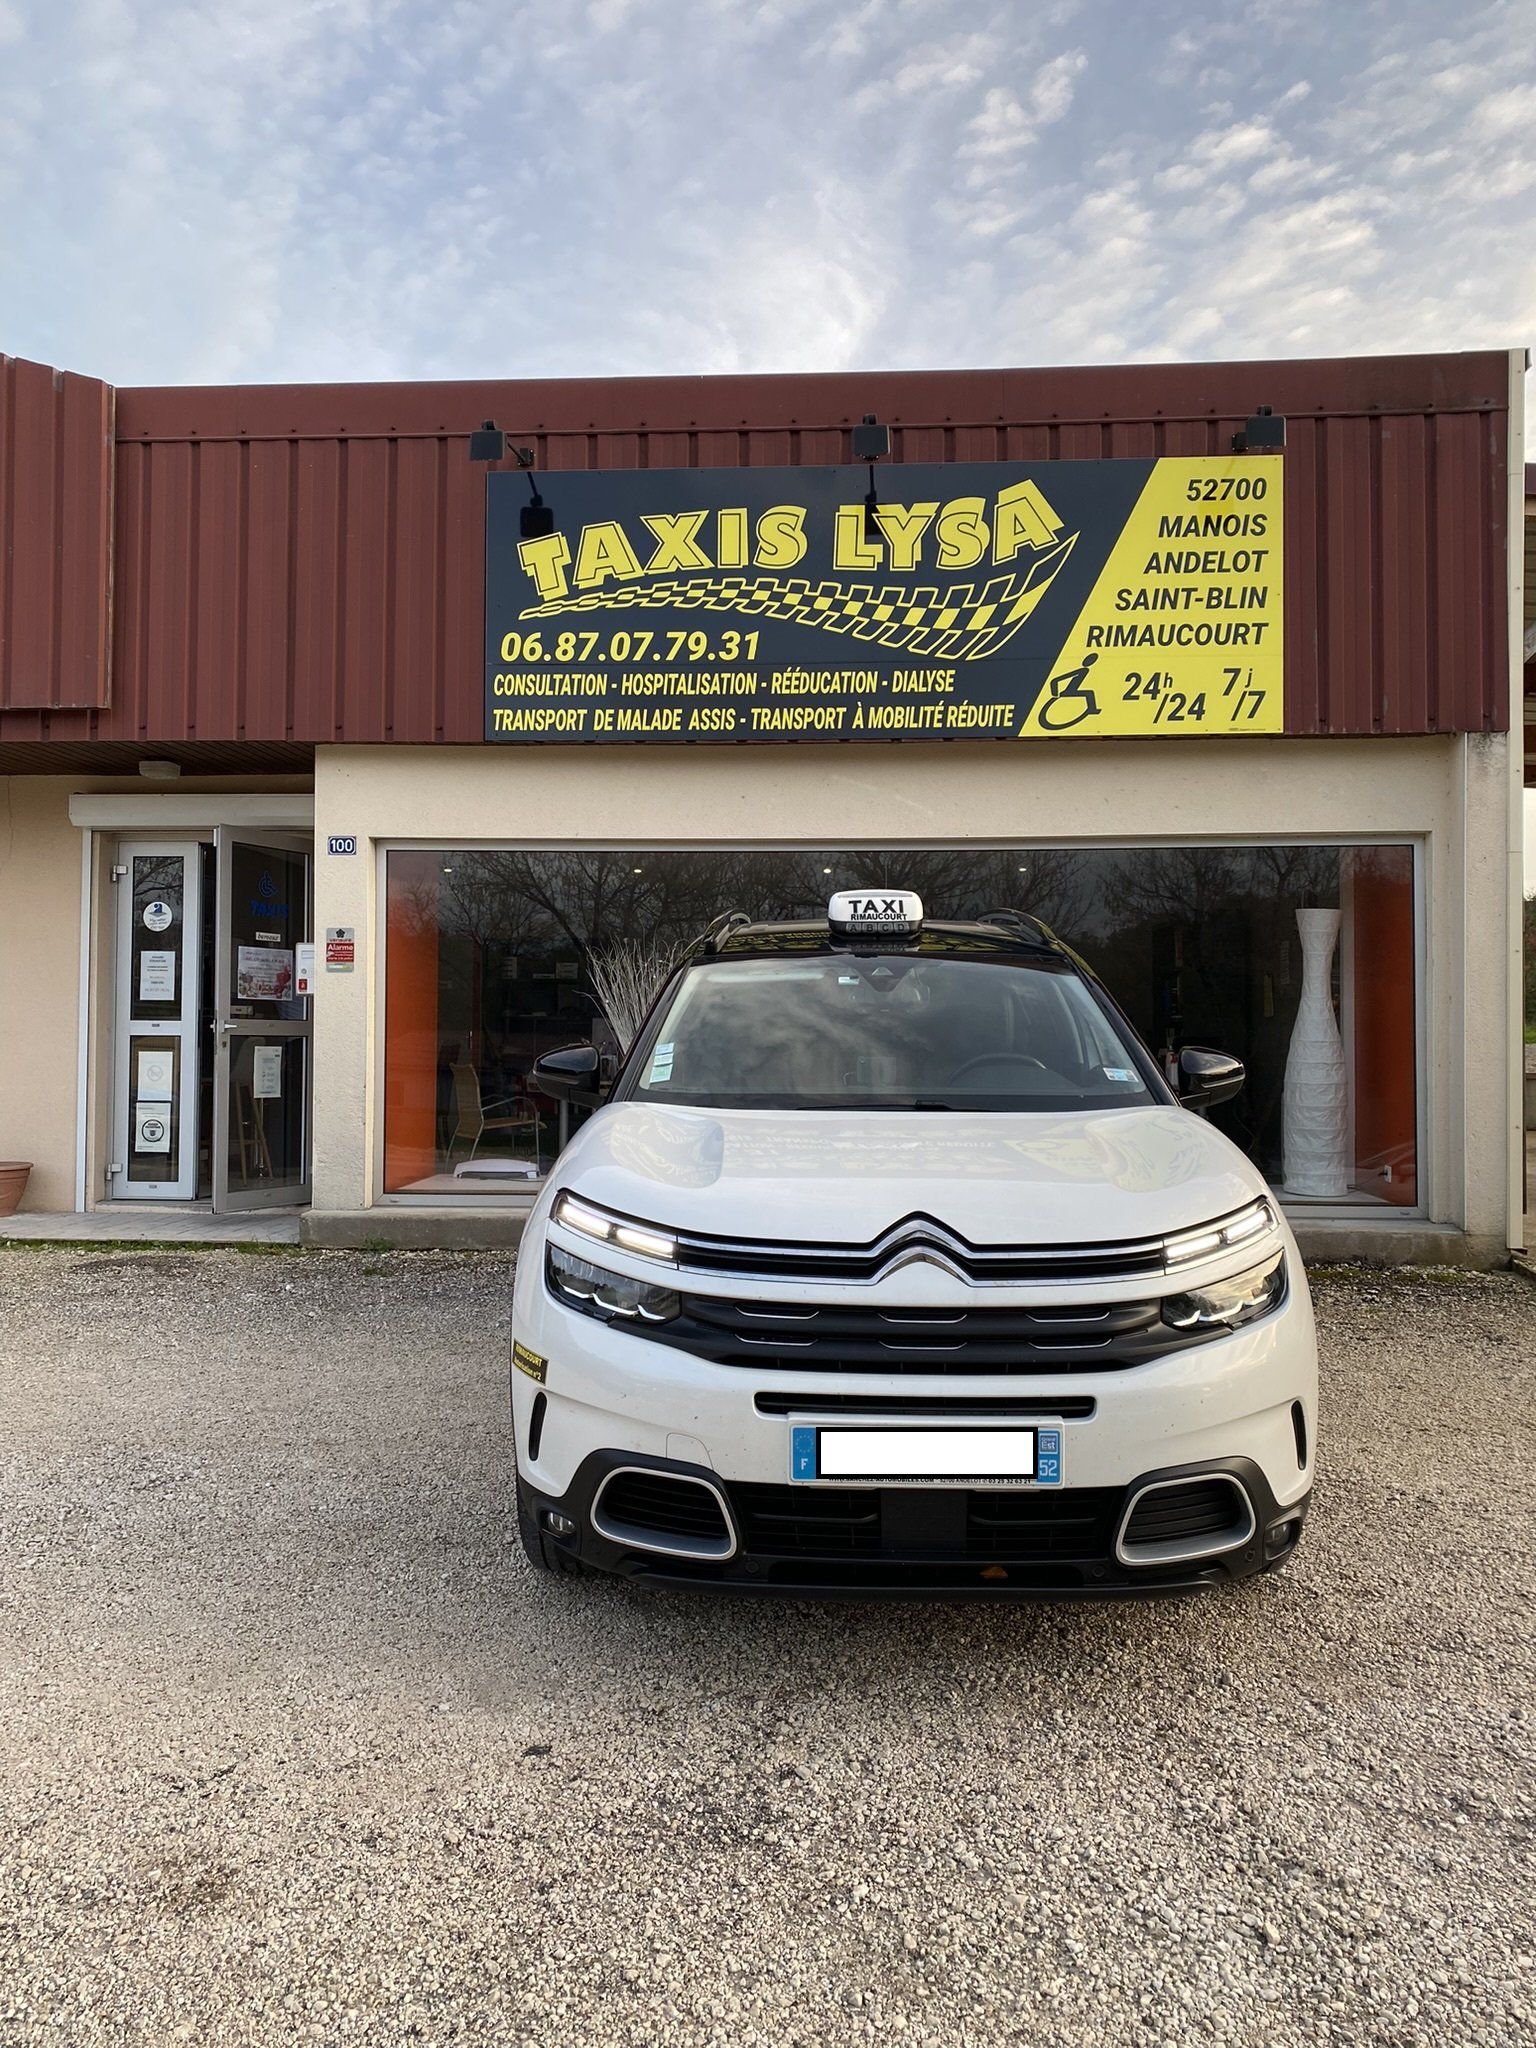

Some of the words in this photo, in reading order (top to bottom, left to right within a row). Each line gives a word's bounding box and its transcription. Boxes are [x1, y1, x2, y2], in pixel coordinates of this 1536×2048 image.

[1186, 478, 1267, 501] 52700
[1158, 514, 1268, 538] MANOIS
[516, 504, 808, 600] TAXIS
[833, 478, 1065, 571] LYSA
[1143, 550, 1269, 574] ANDELOT
[1115, 586, 1268, 611] SAINT-BLIN
[500, 630, 760, 662] 06.87.07.79.31
[1086, 623, 1270, 648] RIMAUCOURT
[493, 673, 608, 696] CONSULTATION
[621, 673, 758, 696] HOSPITALISATION
[770, 667, 878, 695] RÉÉDUCATION
[891, 669, 956, 693] DIALYSE
[493, 708, 588, 731] TRANSPORT
[593, 708, 615, 731] DE
[616, 708, 683, 731] MALADE
[687, 708, 737, 731] ASSIS
[750, 706, 847, 730] TRANSPORT
[851, 701, 864, 729] À
[867, 700, 945, 729] MOBILITÉ
[945, 699, 1015, 728] RÉDUITE
[330, 839, 354, 852] 100
[848, 899, 905, 913] TAXI
[850, 913, 908, 921] RIMAUCOURT
[849, 924, 857, 933] A
[866, 924, 874, 932] B
[882, 924, 889, 932] C
[897, 924, 905, 932] D
[800, 1457, 808, 1471] F
[1039, 1459, 1058, 1476] 52
